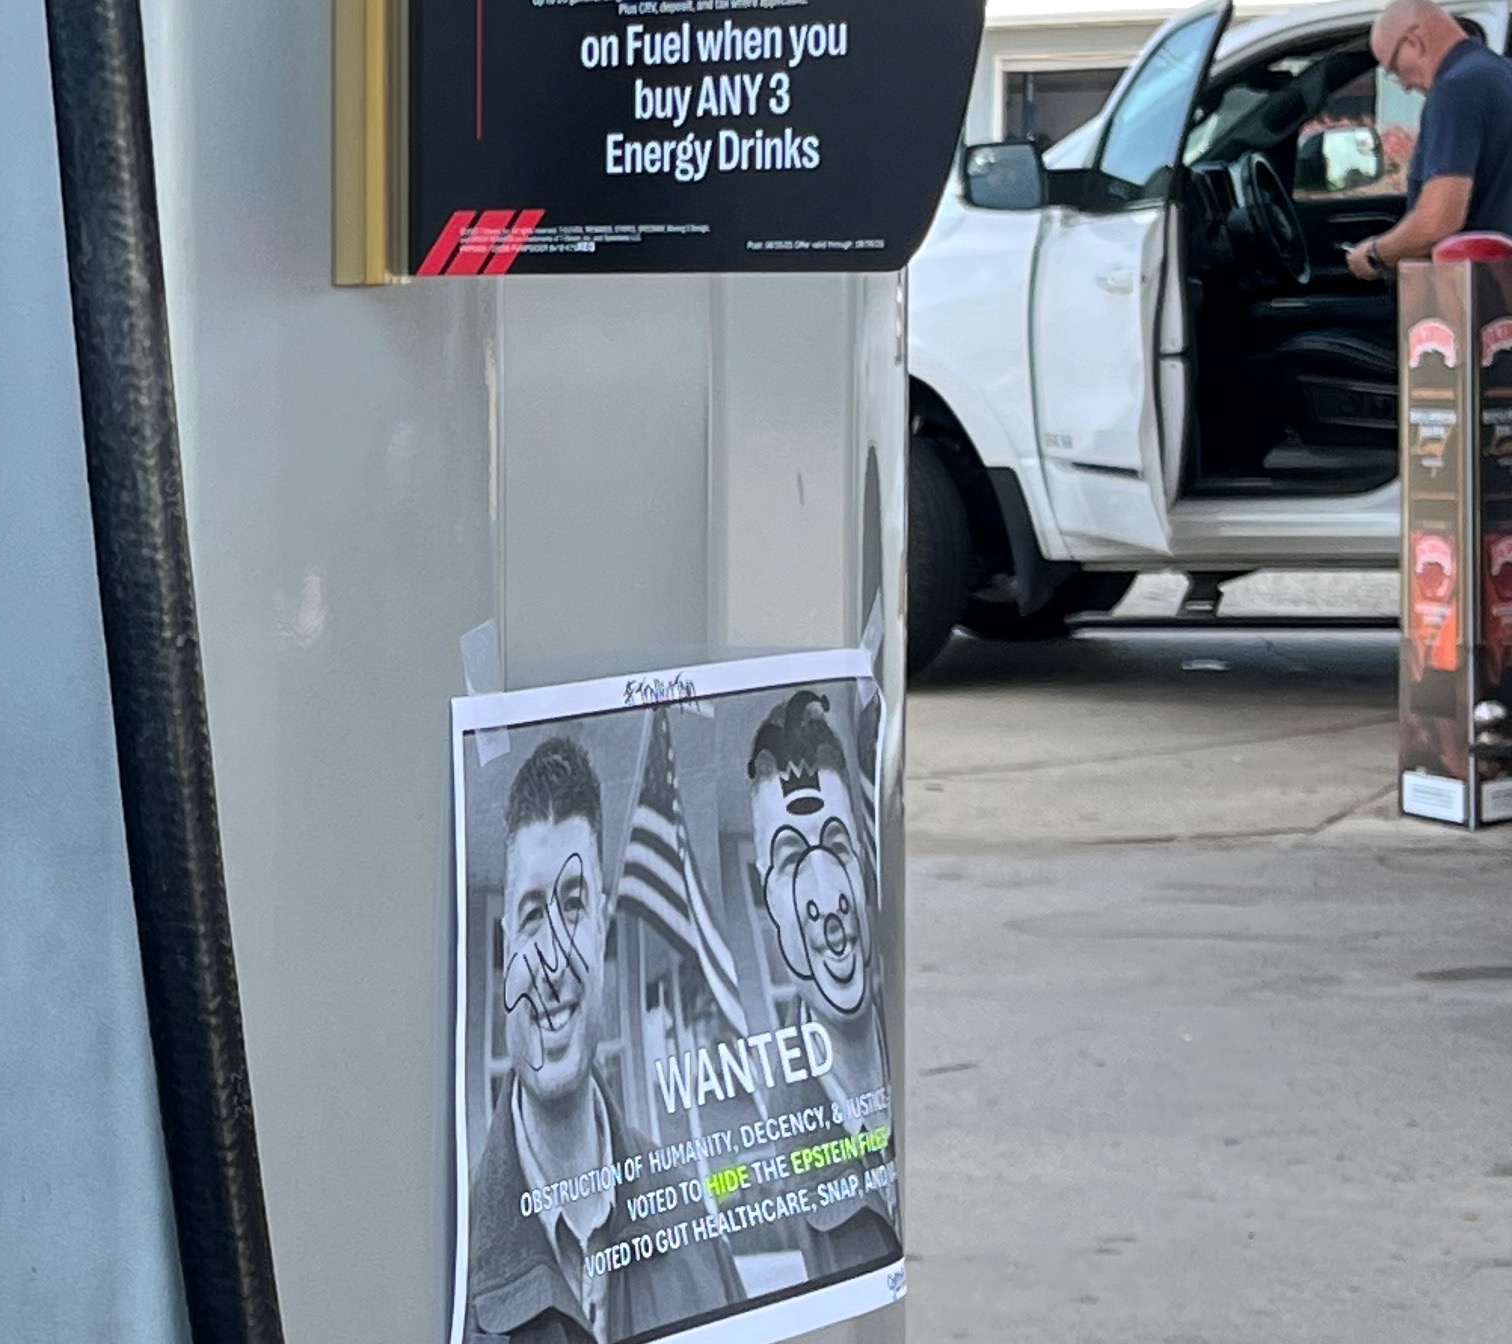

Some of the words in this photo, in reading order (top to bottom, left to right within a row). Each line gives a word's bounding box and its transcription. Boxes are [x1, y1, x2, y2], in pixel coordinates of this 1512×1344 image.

[581, 32, 619, 68] on
[626, 22, 692, 67] Fuel
[696, 20, 783, 64] when
[789, 21, 848, 67] you
[634, 78, 693, 127] buy
[696, 73, 762, 118] ANY
[769, 72, 790, 116] 3
[606, 131, 713, 182] Energy
[719, 127, 820, 171] Drinks
[655, 1021, 833, 1114] WANTED
[520, 1165, 622, 1218] OBSTRUCTION
[625, 1157, 643, 1182] OF
[650, 1133, 738, 1176] HUMANITY,
[741, 1106, 830, 1148] DECENCY,
[832, 1101, 842, 1124] &
[627, 1184, 677, 1221] VOTED
[679, 1179, 701, 1203] TO
[704, 1167, 751, 1197] HIDE
[753, 1157, 789, 1184] THE
[791, 1138, 858, 1174] EPSTEIN
[584, 1243, 631, 1278] VOTED
[633, 1235, 653, 1260] TO
[656, 1225, 689, 1253] GUT
[693, 1188, 818, 1242] HEALTHCARE,
[819, 1176, 864, 1207] SNAP,
[864, 1167, 886, 1192] AND
